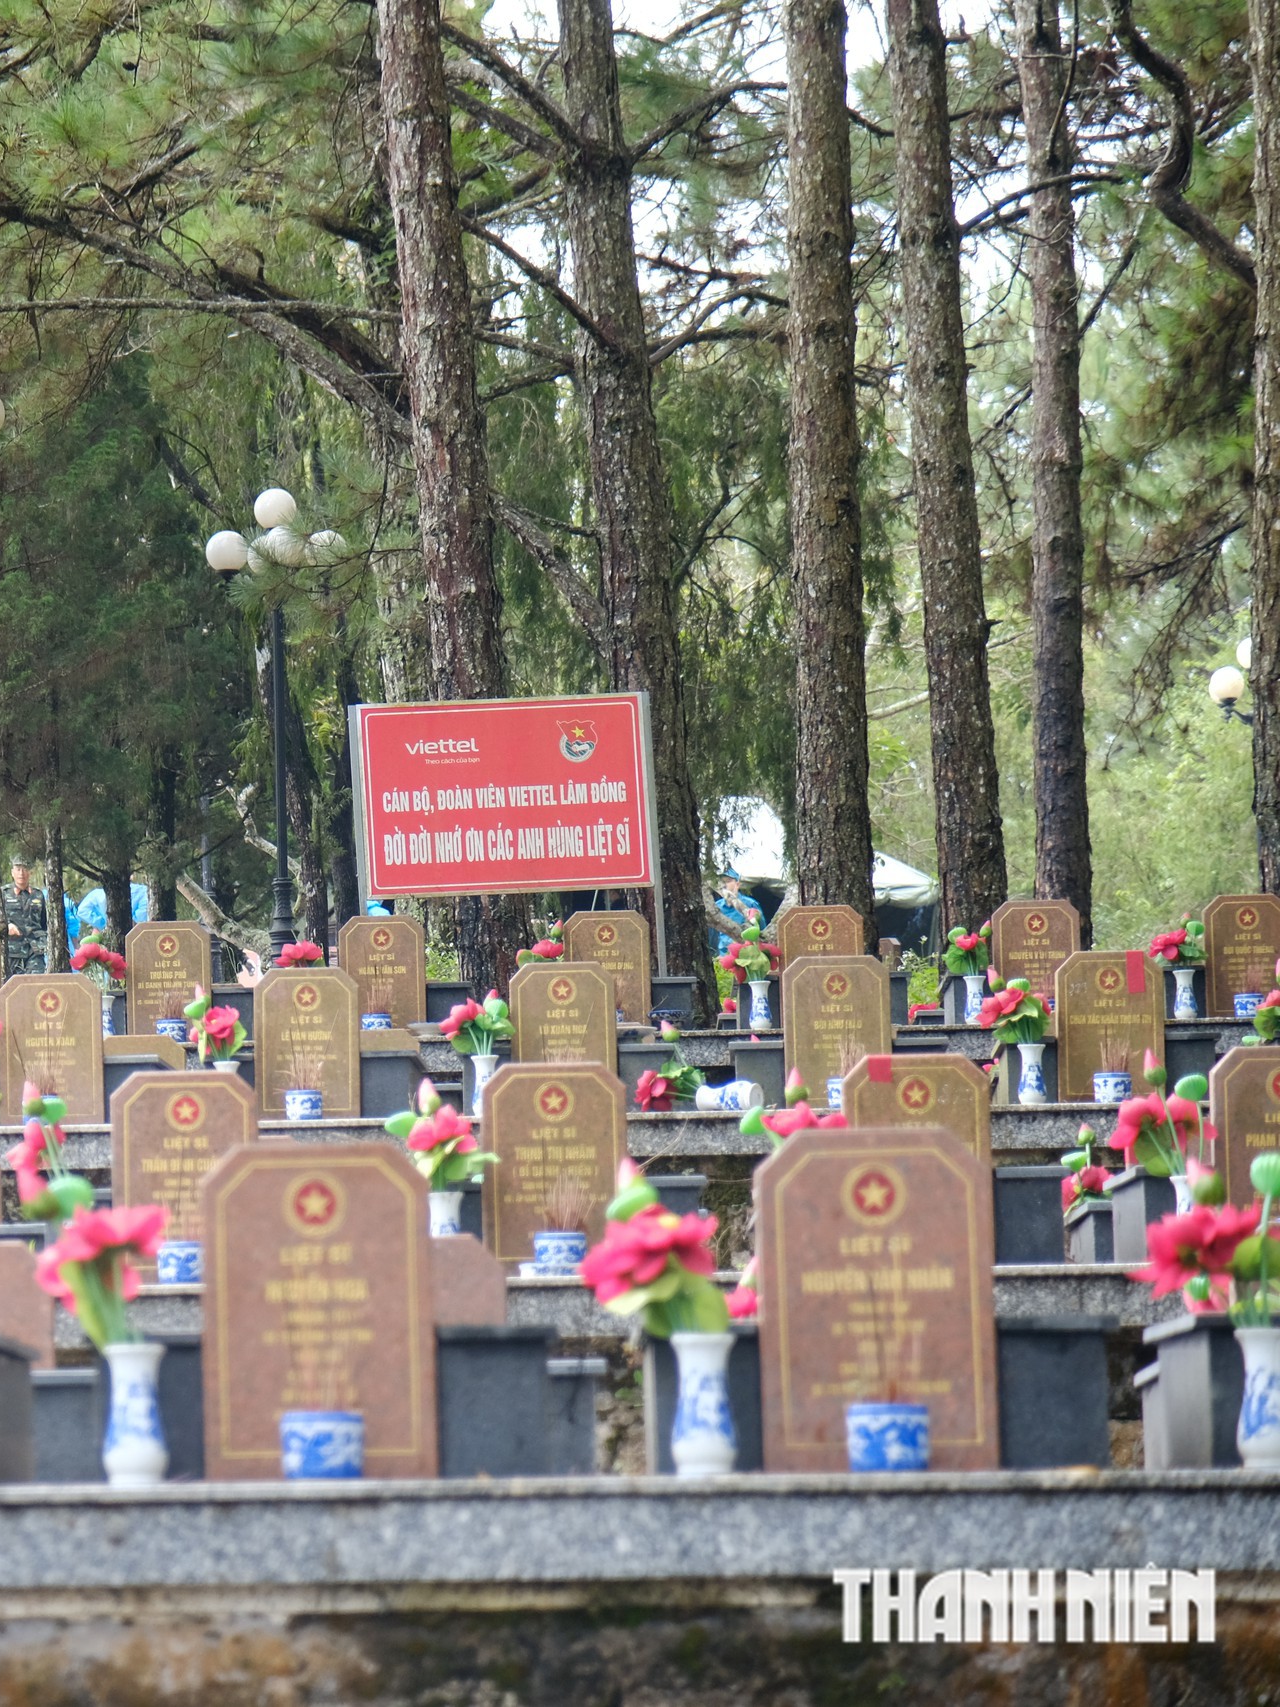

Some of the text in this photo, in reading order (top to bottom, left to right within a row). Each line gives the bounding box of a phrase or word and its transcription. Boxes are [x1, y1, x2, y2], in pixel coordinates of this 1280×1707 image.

[405, 738, 479, 755] viettel
[440, 756, 455, 764] cách
[382, 775, 627, 815] CÁN BỘ, ĐOÀN VIÊN VIETTEL LÂM ĐỒNG
[384, 817, 631, 866] ĐỜI ĐỜI NHỚ ƠN CÁC ANH HÙNG LIỆT SĨ
